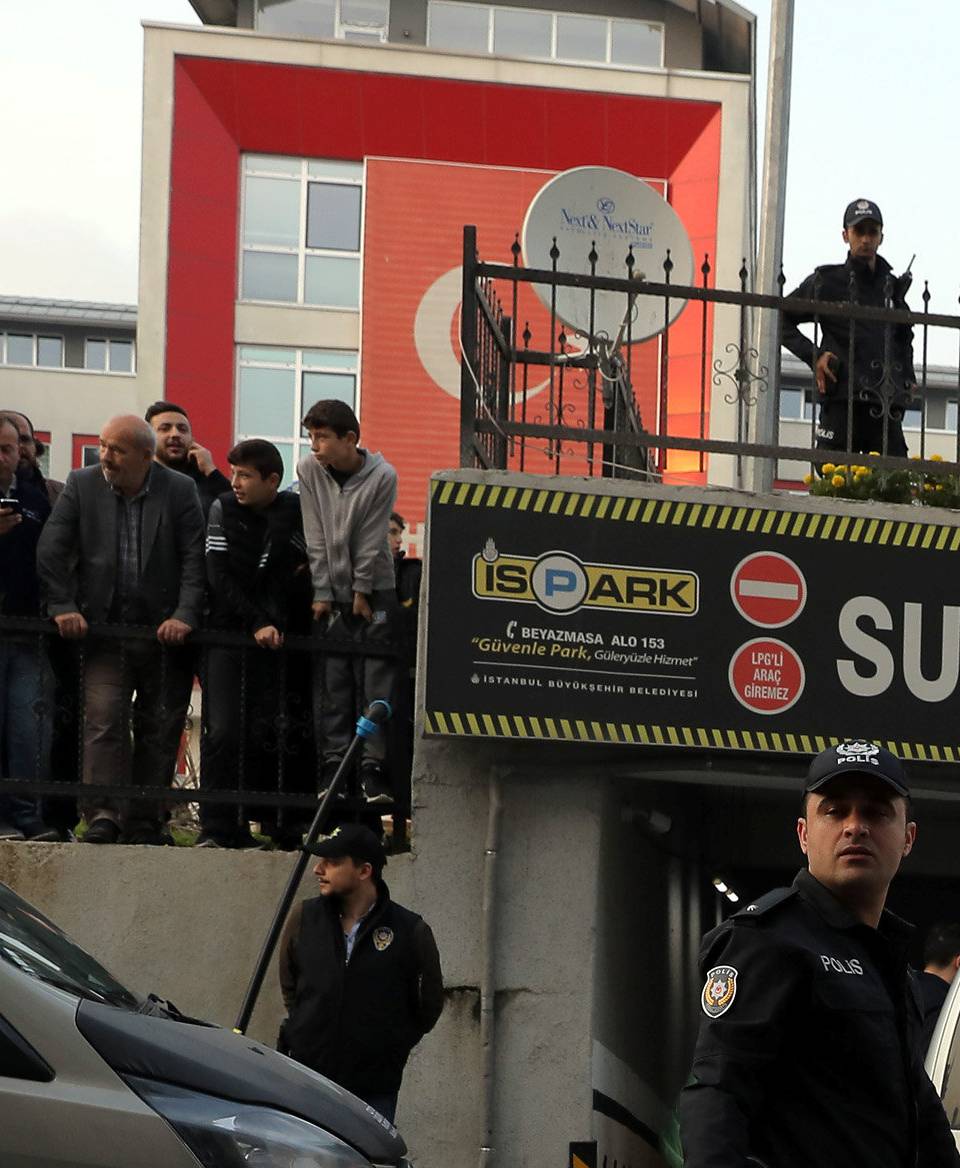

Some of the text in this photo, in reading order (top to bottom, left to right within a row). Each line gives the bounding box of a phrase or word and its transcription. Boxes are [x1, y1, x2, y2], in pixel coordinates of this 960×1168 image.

[521, 627, 665, 650] BEYAZMASA ALO 153
[550, 643, 592, 661] Park,
[594, 649, 652, 665] Güleryüzle
[483, 674, 542, 687] İSTANBUL
[629, 686, 698, 698] BELEDİYESİ
[753, 668, 782, 686] ARAÇ
[744, 682, 789, 701] GİREMEZ
